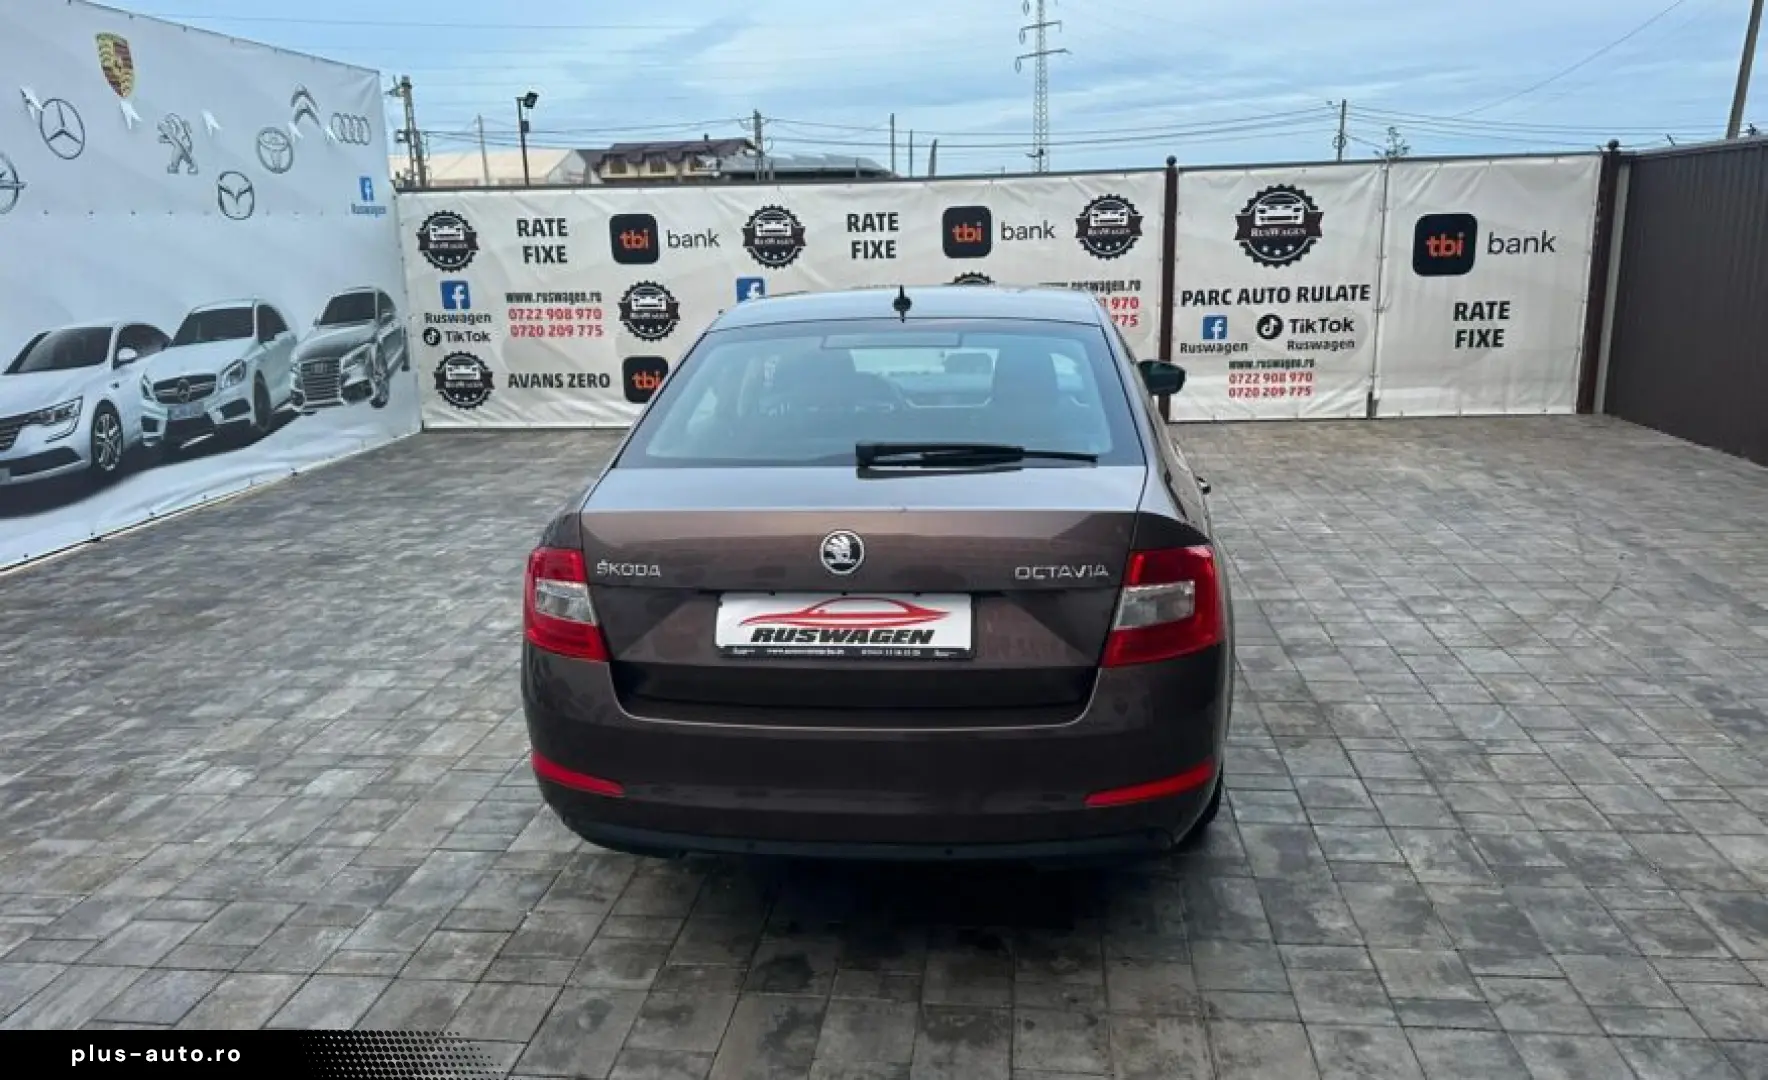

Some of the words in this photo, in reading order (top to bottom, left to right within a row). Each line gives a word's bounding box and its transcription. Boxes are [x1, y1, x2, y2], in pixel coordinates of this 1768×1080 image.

[517, 217, 568, 237] RATE
[847, 212, 899, 233] RATE
[619, 229, 650, 249] tbi
[666, 228, 720, 249] bank
[952, 222, 982, 243] tbi
[1000, 220, 1056, 241] bank
[851, 240, 897, 259] FIXE
[1426, 232, 1466, 257] tbi
[1487, 230, 1556, 254] bank
[523, 244, 568, 264] FIXE
[505, 292, 602, 305] www.ruswagen.ro
[1111, 296, 1139, 309] 970
[1180, 288, 1232, 307] PARC
[1236, 286, 1290, 304] AUTO
[1297, 284, 1371, 303] RULATE
[424, 312, 492, 325] Ruswagen
[508, 308, 543, 321] 0722
[546, 308, 573, 320] 908
[575, 308, 602, 320] 970
[1453, 300, 1510, 321] RATE
[510, 324, 545, 337] 0720
[548, 324, 574, 337] 209
[576, 324, 604, 337] 775
[1289, 317, 1355, 334] TikTok
[444, 330, 492, 343] TikTok
[1287, 339, 1355, 351] Ruswagen
[1455, 328, 1505, 349] FIXE
[1180, 342, 1248, 355] Ruswagen
[508, 372, 564, 389] AVANS
[567, 372, 611, 389] ZERO
[631, 371, 661, 390] tbi
[1228, 372, 1260, 385] 0722
[1289, 371, 1313, 382] 970
[1228, 387, 1260, 398] 0720
[1263, 386, 1286, 397] 209
[1289, 385, 1312, 397] 775
[596, 559, 662, 577] ŠKODA
[1014, 563, 1109, 580] OCTAVIA
[751, 627, 935, 645] RUSWAGEN
